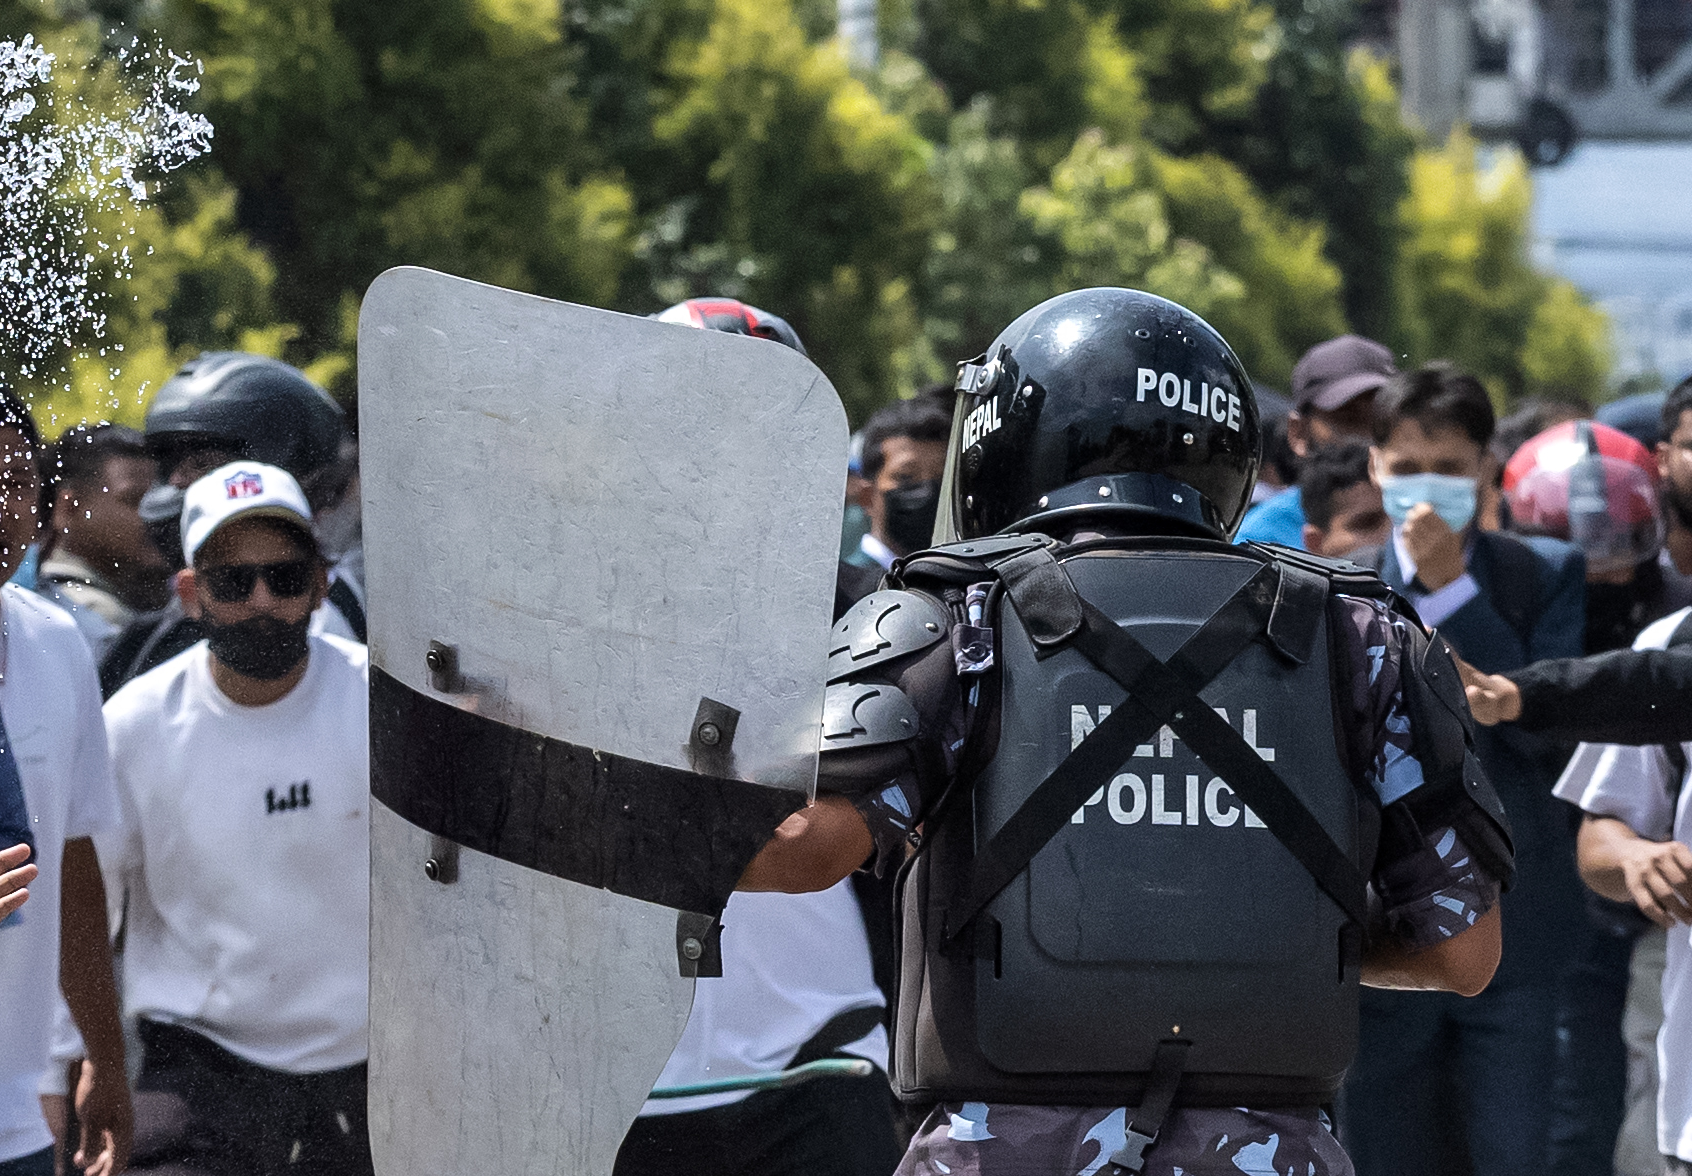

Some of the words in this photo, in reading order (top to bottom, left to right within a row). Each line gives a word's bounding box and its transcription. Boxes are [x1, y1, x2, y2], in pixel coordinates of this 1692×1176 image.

[962, 396, 1002, 453] NEPAL
[1136, 368, 1241, 432] POLICE
[1071, 705, 1275, 761] NPL
[1071, 773, 1269, 828] OLIC
